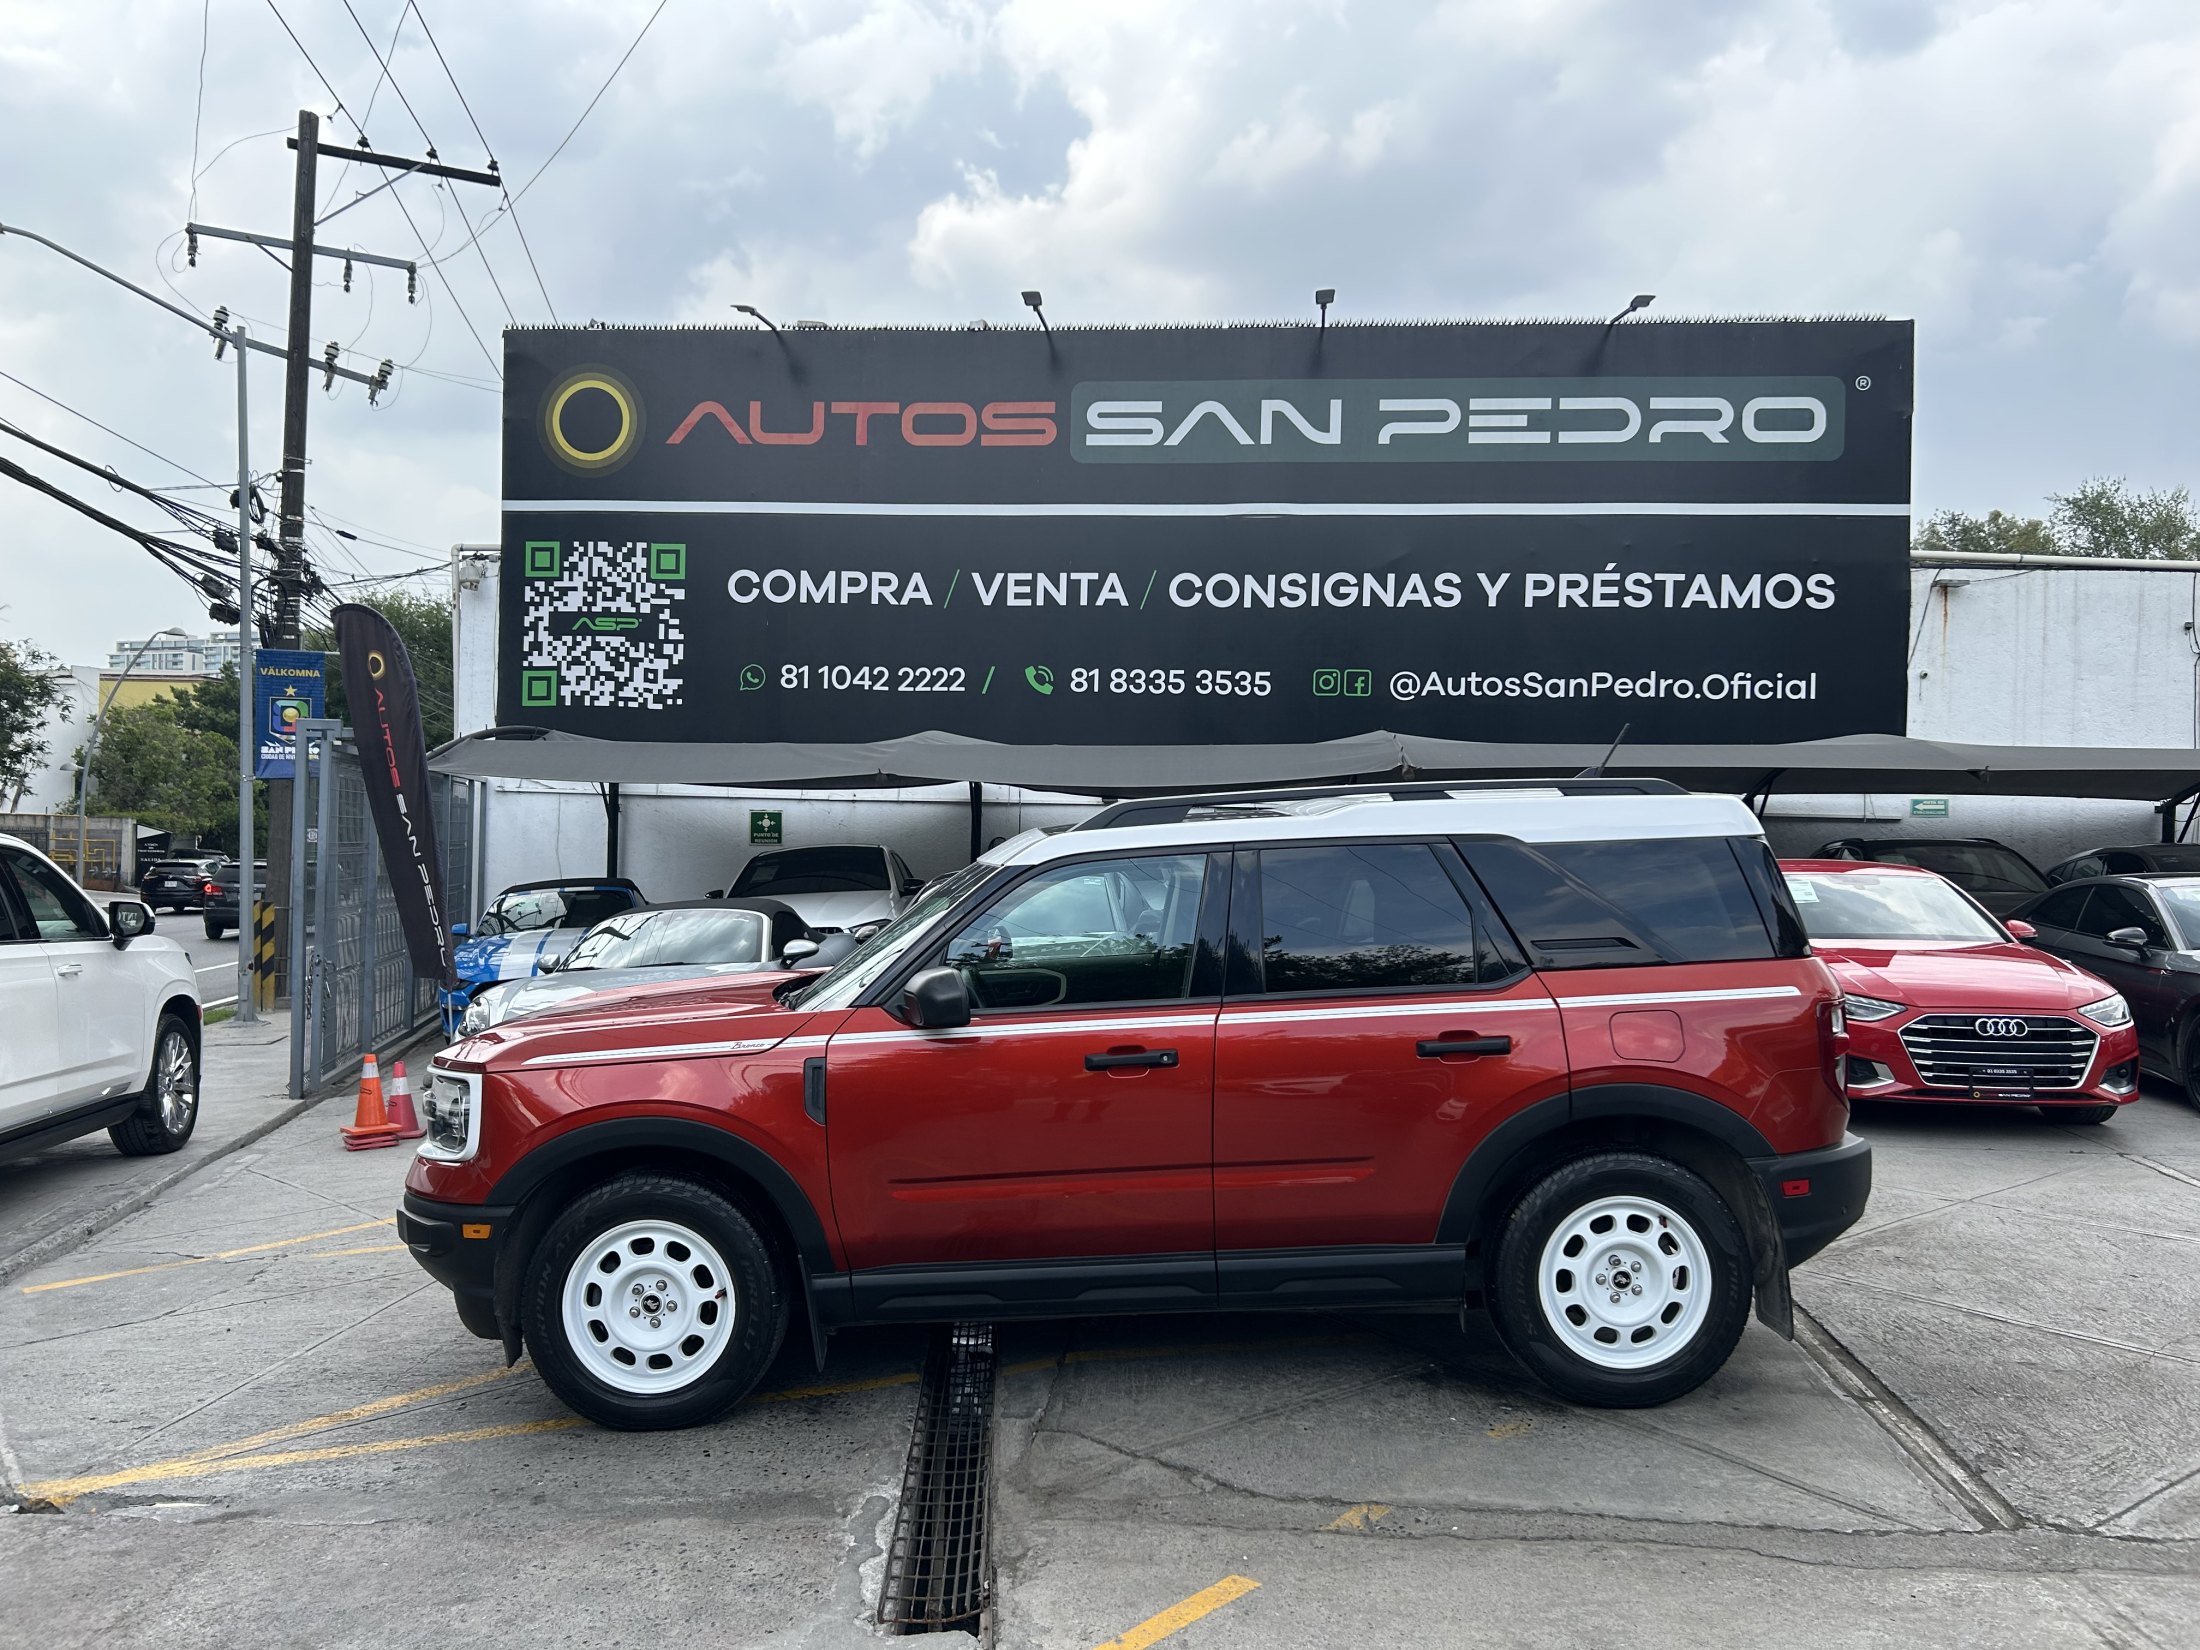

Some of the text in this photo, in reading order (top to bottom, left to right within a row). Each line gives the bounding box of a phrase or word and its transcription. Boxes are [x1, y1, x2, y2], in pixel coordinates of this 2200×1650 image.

[666, 400, 1058, 447] AUTOS
[1085, 399, 1343, 446] SAN
[1377, 396, 1828, 445] PEDRO
[727, 568, 934, 606] COMPRA
[970, 571, 1130, 607] VENTA
[1168, 572, 1462, 609] CONSIGNAS
[1476, 572, 1512, 608] Y
[1524, 562, 1836, 610] PRÉSTAMOS
[571, 616, 639, 631] ASP
[260, 665, 320, 678] VÄLKOMNA
[780, 663, 809, 689] 81
[816, 664, 890, 692] 1042
[897, 666, 966, 692] 2222
[1069, 667, 1272, 697] 81 8335 3535
[1389, 670, 1817, 701] @AutosSanPedro.Oficial
[375, 687, 401, 789] AUTOS
[396, 792, 421, 858] SAN
[731, 1041, 765, 1050] Bronco
